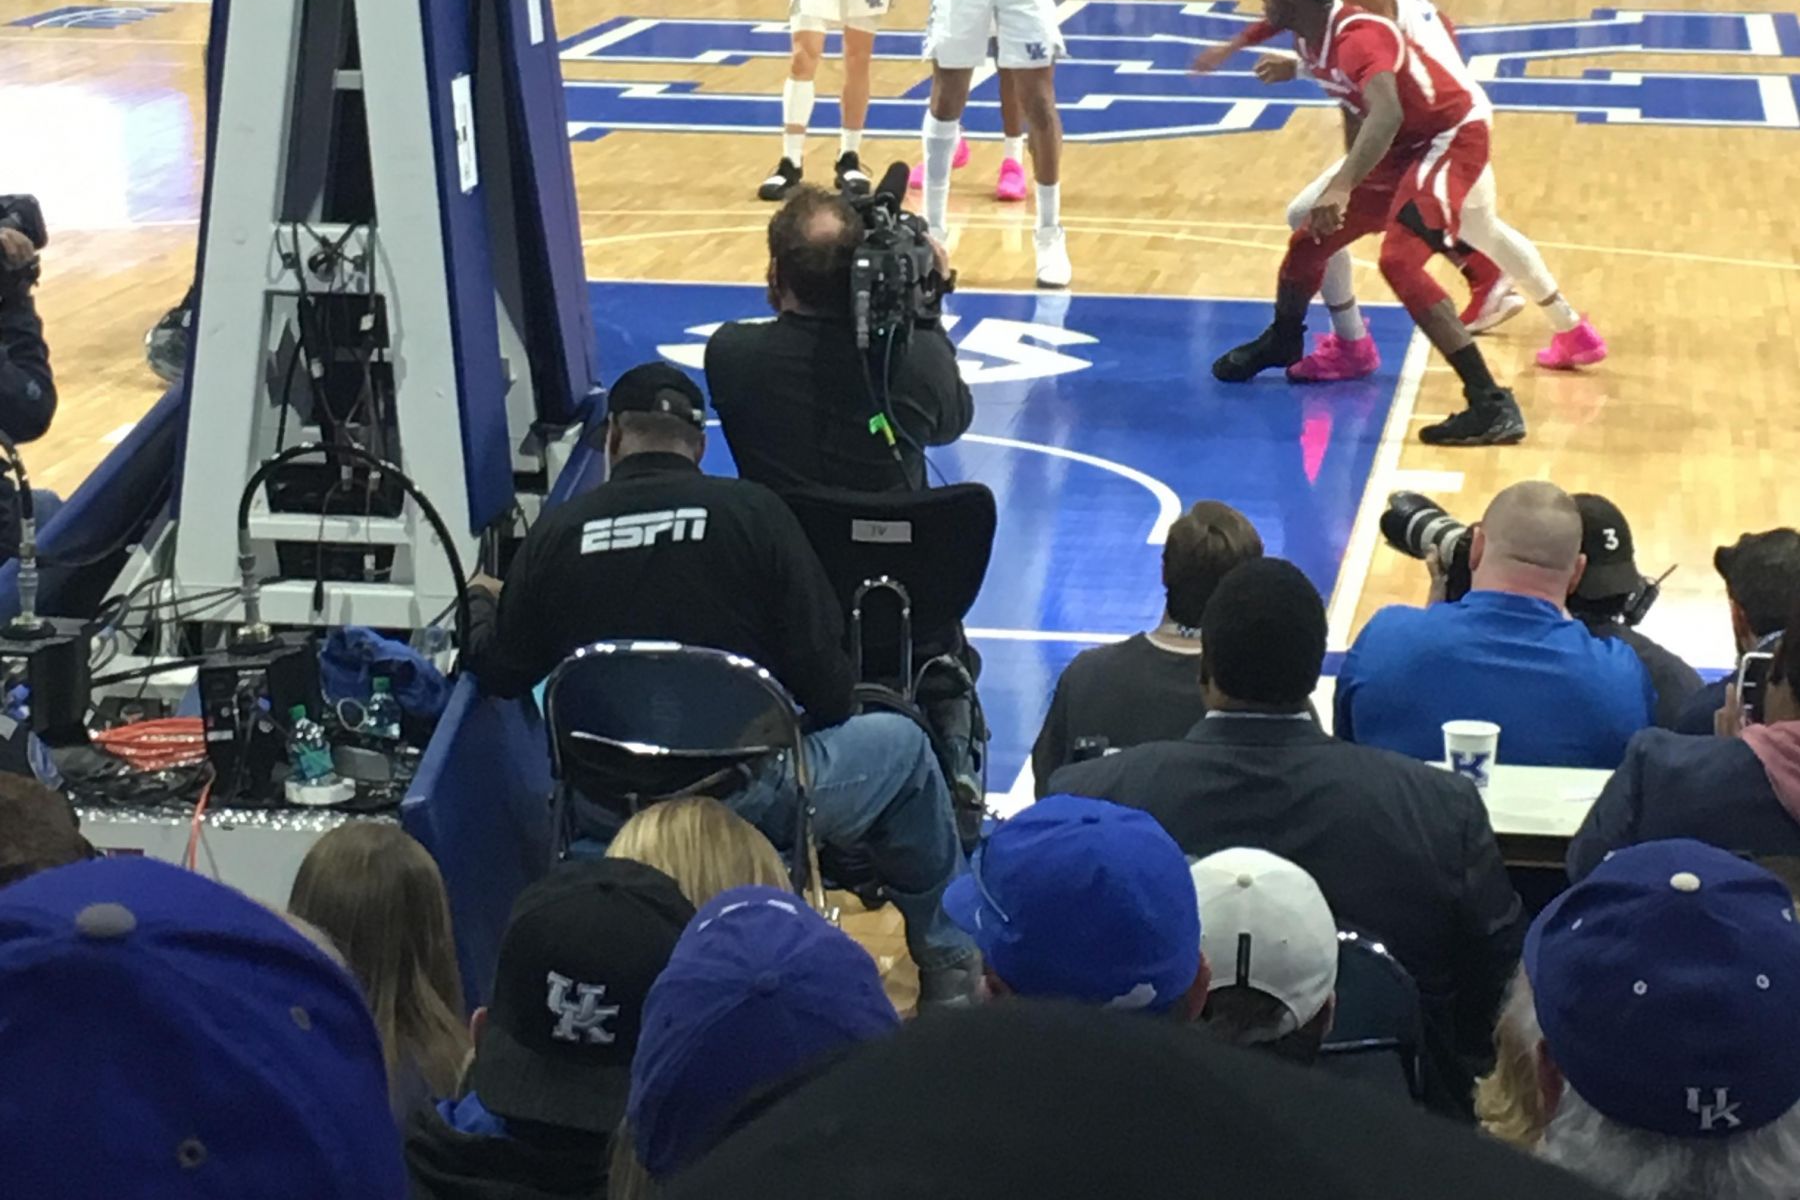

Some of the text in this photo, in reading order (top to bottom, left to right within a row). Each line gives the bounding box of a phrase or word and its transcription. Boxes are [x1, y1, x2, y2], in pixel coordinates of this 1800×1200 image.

[580, 507, 708, 555] ESPN
[1602, 528, 1619, 551] 3
[547, 970, 620, 1043] UK
[1685, 1087, 1742, 1131] UK
